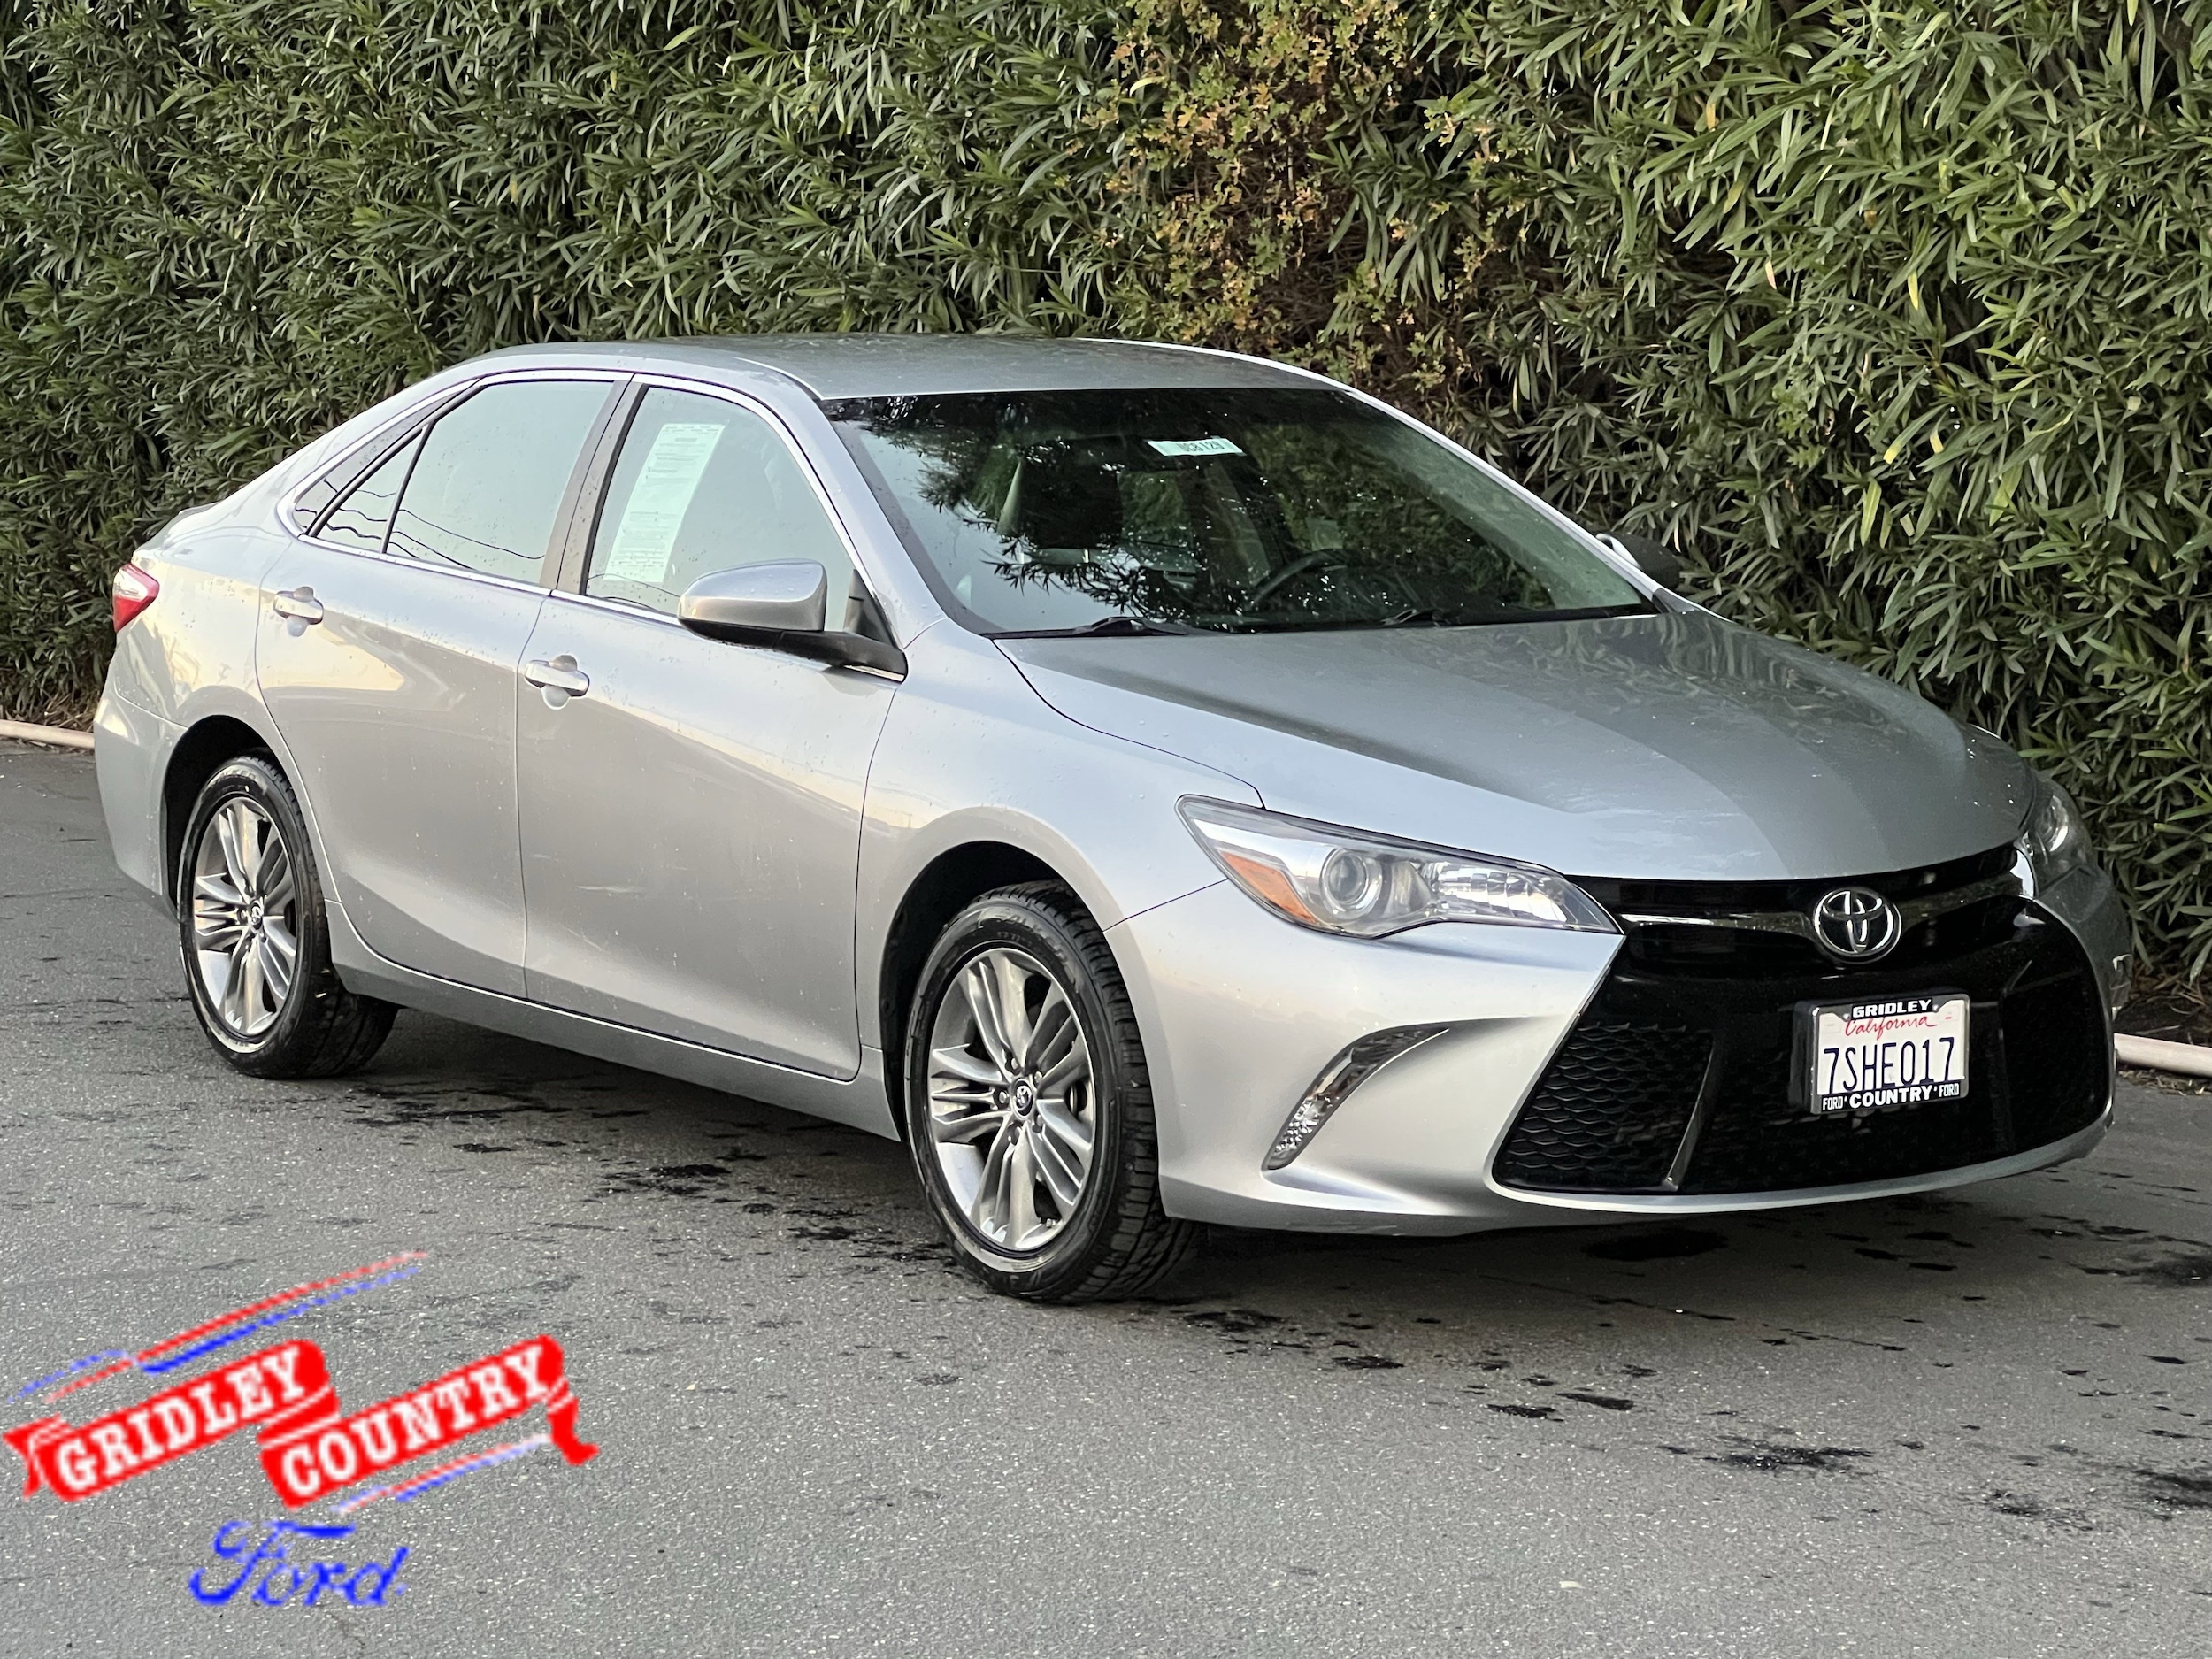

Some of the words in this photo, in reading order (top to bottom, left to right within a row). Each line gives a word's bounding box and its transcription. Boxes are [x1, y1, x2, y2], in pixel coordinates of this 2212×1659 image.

[1852, 999, 1932, 1018] GRIDLEY
[1844, 1015, 1938, 1040] California
[1824, 1037, 1954, 1094] 7SHE017
[1822, 1095, 1844, 1110] FORD
[1849, 1085, 1933, 1109] COUNTRY
[1939, 1083, 1960, 1097] FORD
